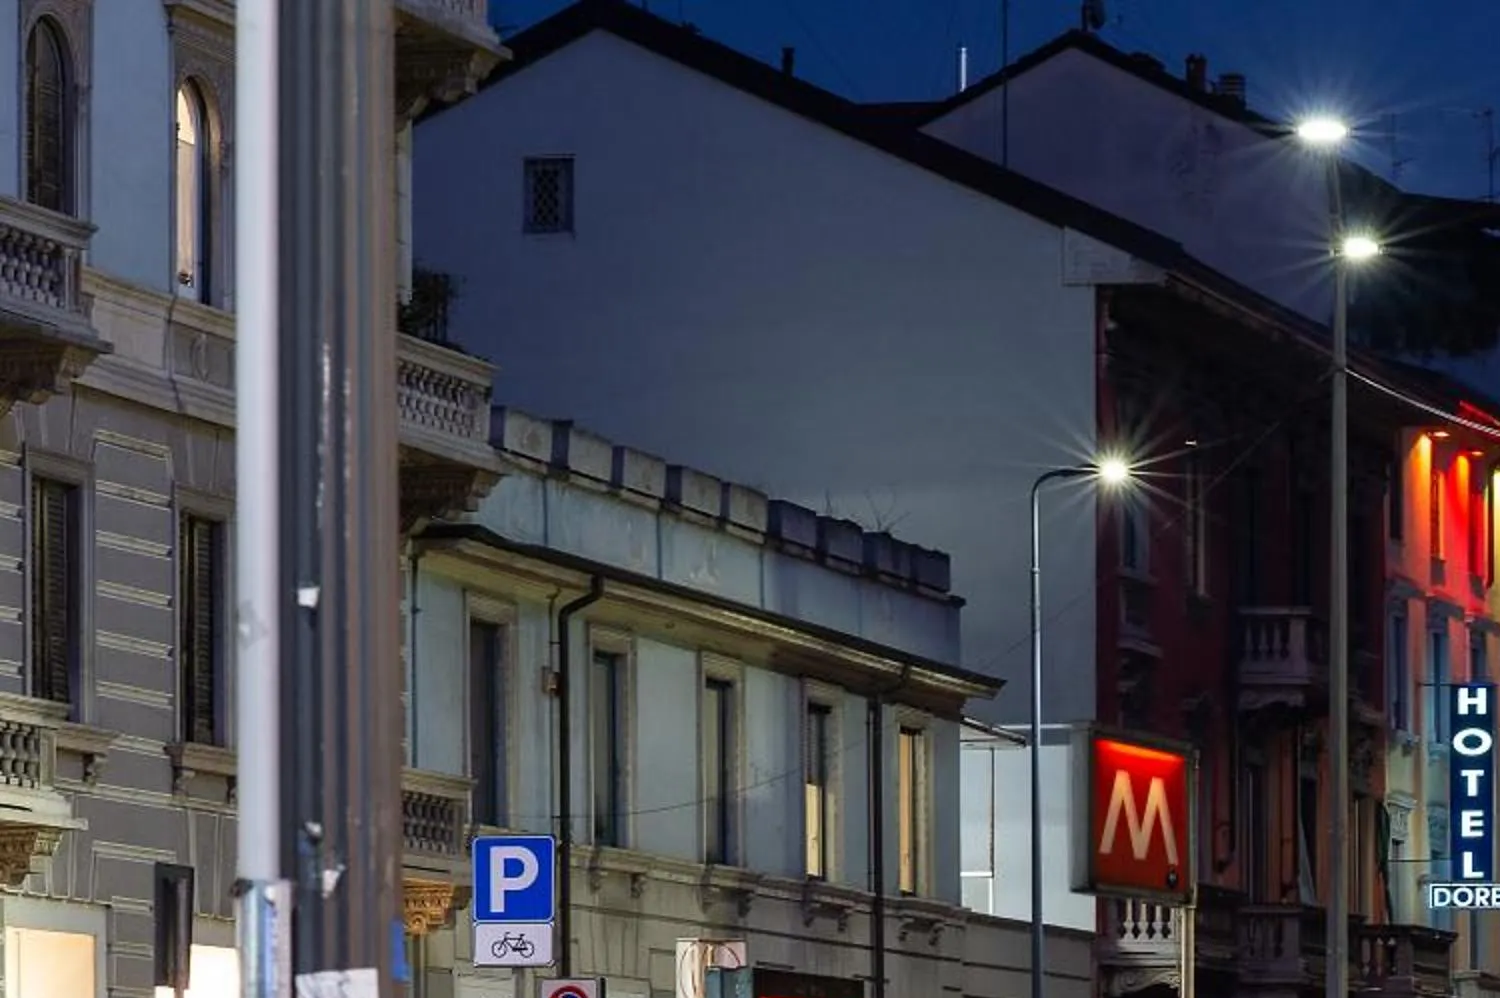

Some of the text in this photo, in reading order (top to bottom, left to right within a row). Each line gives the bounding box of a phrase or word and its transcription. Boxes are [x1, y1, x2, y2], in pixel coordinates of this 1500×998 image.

[1099, 769, 1179, 866] M
[1452, 687, 1493, 878] HOTEL
[489, 845, 539, 913] P
